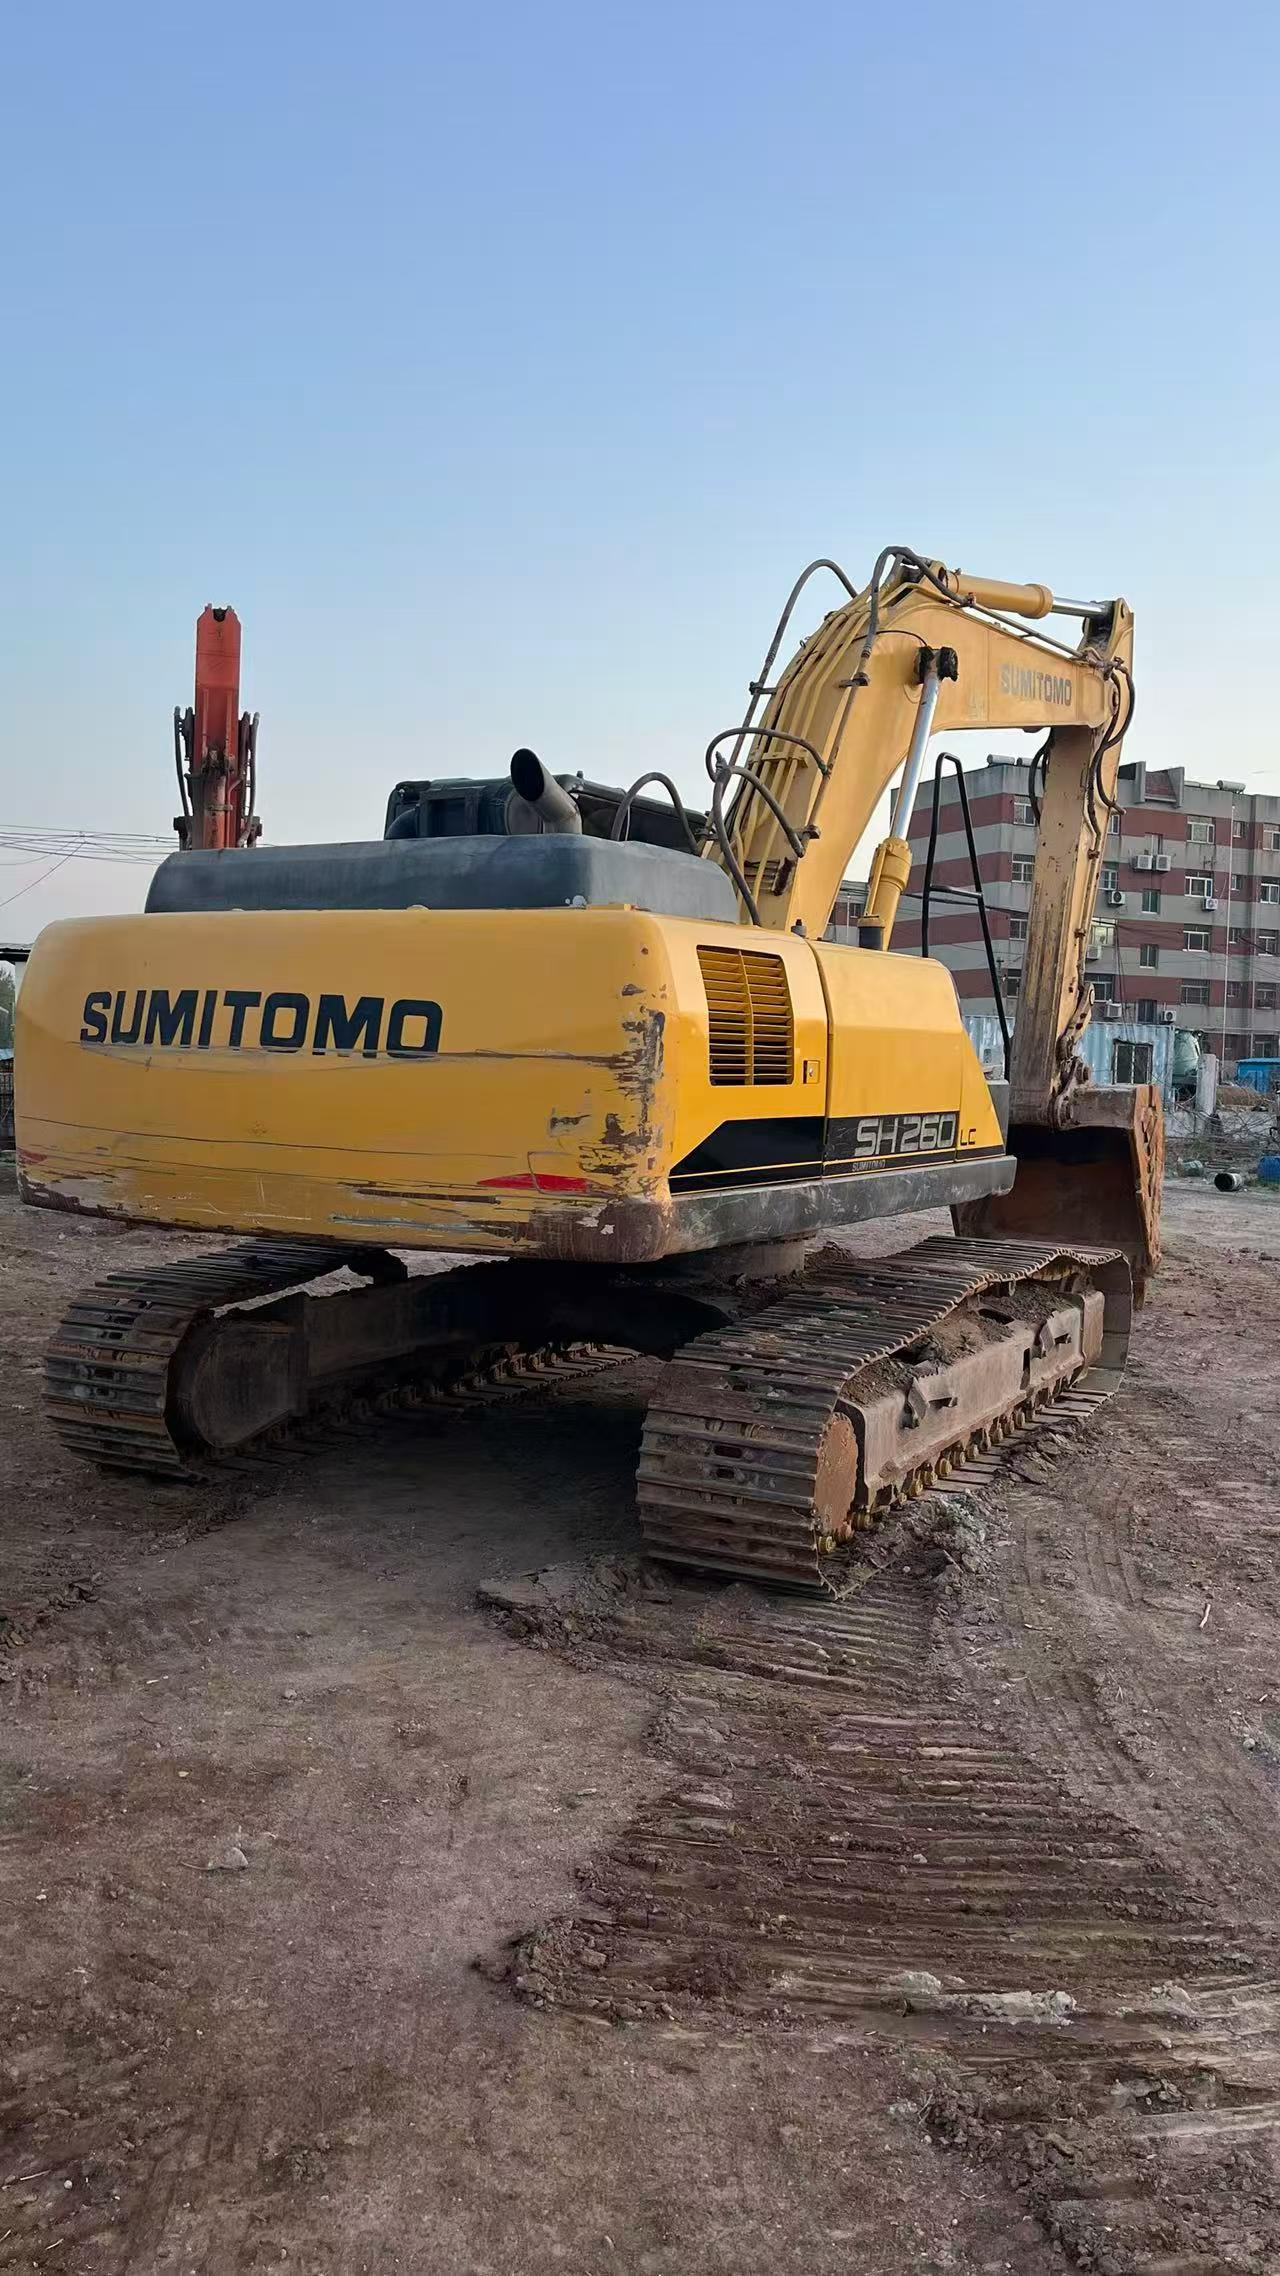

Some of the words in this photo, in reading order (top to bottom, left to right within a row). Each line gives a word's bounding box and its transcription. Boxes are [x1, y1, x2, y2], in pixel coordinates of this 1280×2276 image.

[1001, 663, 1073, 707] SUMITOMO
[80, 990, 443, 1058] SUMITOMO
[960, 1128, 977, 1146] LC
